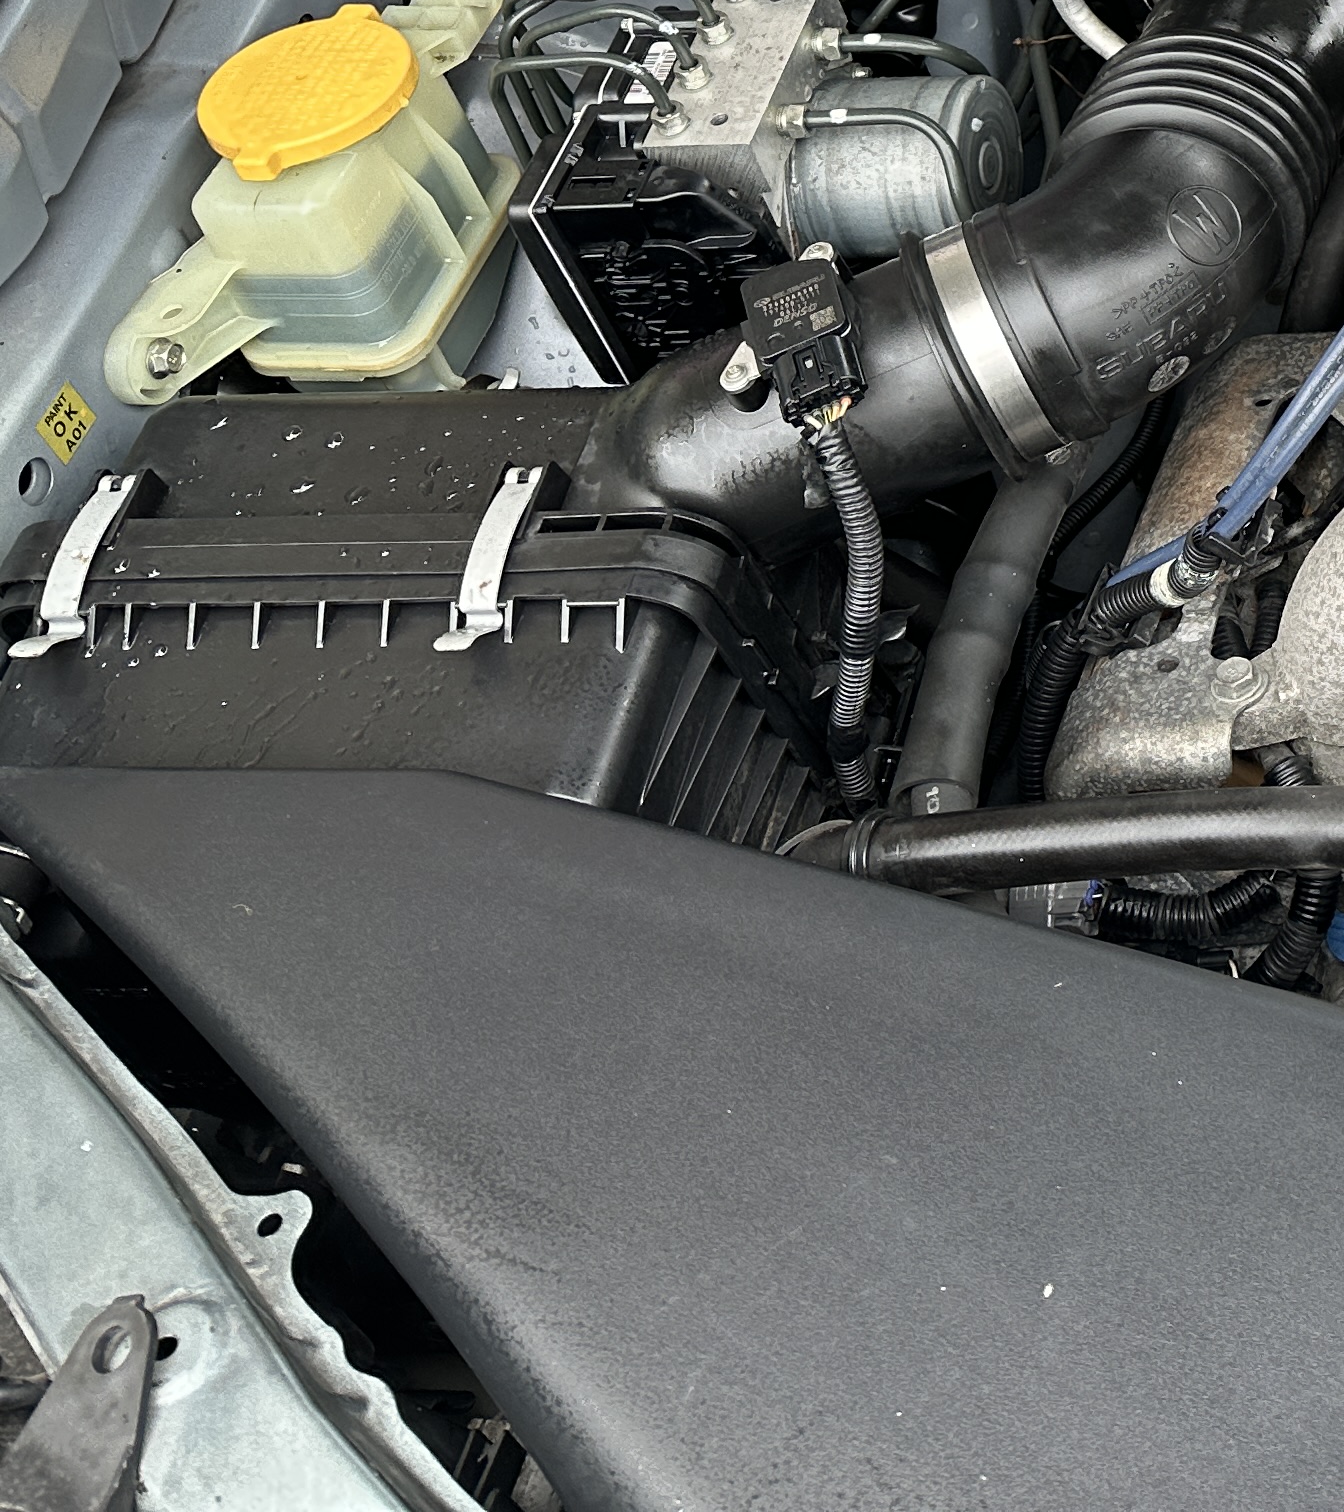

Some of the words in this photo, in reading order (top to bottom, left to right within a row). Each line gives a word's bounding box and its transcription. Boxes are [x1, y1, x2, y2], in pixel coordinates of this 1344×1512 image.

[1096, 280, 1226, 380] SUBARU
[45, 392, 67, 427] PAINT
[66, 420, 87, 452] A01
